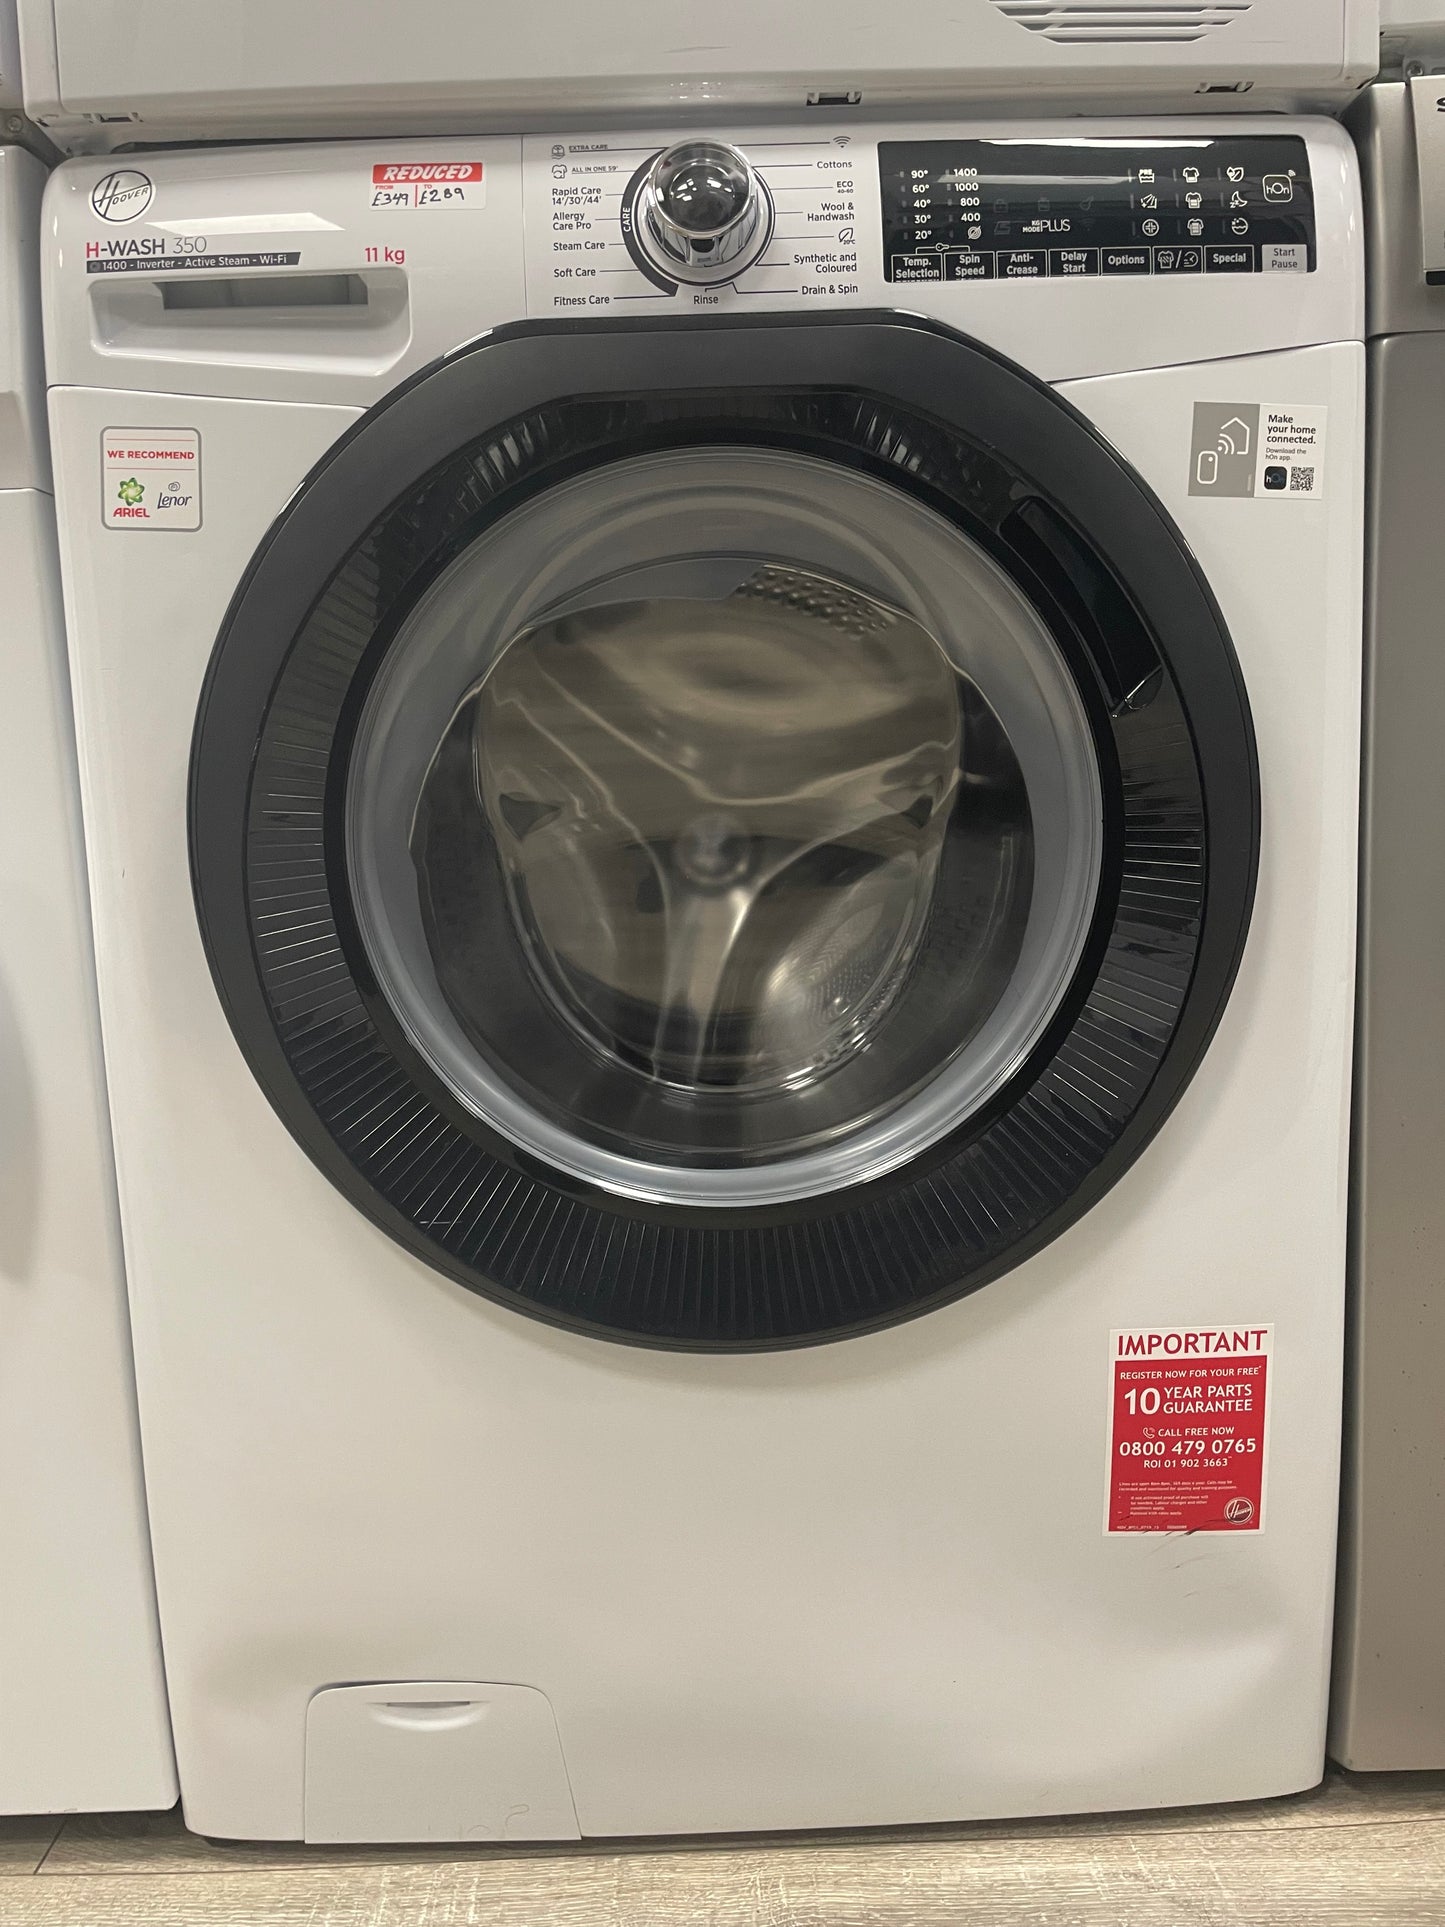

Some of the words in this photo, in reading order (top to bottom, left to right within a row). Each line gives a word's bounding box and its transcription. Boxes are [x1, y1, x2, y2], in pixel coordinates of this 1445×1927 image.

[817, 161, 852, 169] Cottons
[383, 164, 473, 181] REDUCED
[911, 169, 929, 179] 90°
[953, 168, 978, 177] 1400
[836, 180, 853, 188] ECO
[912, 184, 930, 194] 60°
[955, 182, 979, 192] 1000
[1266, 182, 1290, 195] hOn
[94, 174, 150, 218] HOOVER
[418, 187, 465, 205] £289
[552, 187, 578, 196] Rapid
[581, 187, 602, 195] Care
[371, 192, 409, 206] £349
[913, 199, 931, 208] 40°
[960, 198, 980, 207] 800
[821, 202, 845, 211] Wool
[847, 202, 854, 210] &
[553, 212, 585, 221] Allergy
[623, 207, 631, 232] CARE
[807, 212, 855, 221] Handwash
[914, 214, 932, 224] 30°
[960, 212, 981, 222] 400
[553, 222, 573, 230] Care
[576, 222, 592, 230] Pro
[1040, 219, 1071, 232] PLUS
[915, 230, 932, 240] 20°
[86, 238, 165, 258] H-WASH
[172, 236, 207, 254] 350
[553, 242, 582, 251] Steam
[584, 241, 605, 250] Care
[365, 247, 378, 262] 11
[385, 246, 405, 265] kg
[1061, 251, 1087, 262] Delay
[1273, 247, 1295, 257] Start
[102, 261, 127, 271] 1400
[137, 259, 175, 269] Inverter
[185, 257, 216, 267] Active
[219, 256, 250, 266] Steam
[260, 254, 287, 265] Wi-Fi
[794, 253, 837, 264] Synthetic
[839, 252, 857, 262] and
[902, 257, 932, 267] Temp.
[959, 254, 980, 265] Spin
[1010, 253, 1034, 263] Anti-
[1108, 255, 1145, 267] Options
[1212, 253, 1247, 265] Special
[815, 263, 857, 273] Coloured
[1063, 263, 1086, 273] Start
[1271, 259, 1298, 269] Pause
[554, 268, 573, 278] Soft
[575, 267, 596, 277] Care
[896, 268, 940, 279] Selection
[955, 265, 985, 276] Speed
[1006, 264, 1038, 275] Crease
[802, 285, 826, 295] Drain
[828, 284, 836, 294] &
[837, 283, 858, 295] Spin
[554, 296, 586, 306] Fitness
[589, 295, 610, 305] Care
[693, 295, 719, 305] Rinse
[1268, 414, 1294, 423] Make
[1267, 426, 1289, 435] your
[1290, 425, 1316, 435] home
[1266, 435, 1316, 444] connected.
[107, 450, 125, 459] WE
[128, 451, 195, 460] RECOMMEND
[157, 492, 192, 509] Lenor
[113, 507, 150, 518] ARIEL
[1118, 1330, 1268, 1356] IMPORTANT
[1120, 1370, 1162, 1380] REGISTER
[1165, 1370, 1187, 1379] NOW
[1189, 1369, 1208, 1378] FOR
[1210, 1368, 1235, 1377] YOUR
[1163, 1386, 1202, 1399] YEAR
[1208, 1384, 1252, 1397] PARTS
[1124, 1387, 1161, 1415] 10
[1163, 1399, 1253, 1414] GUARANTEE
[1158, 1428, 1182, 1437] CALL
[1185, 1427, 1208, 1436] FREE
[1211, 1427, 1235, 1435] NOW
[1119, 1441, 1165, 1456] 0800
[1171, 1440, 1206, 1455] 479
[1211, 1438, 1256, 1454] 0765
[1143, 1460, 1161, 1468] ROI
[1164, 1459, 1177, 1468] 01
[1180, 1459, 1200, 1468] 902
